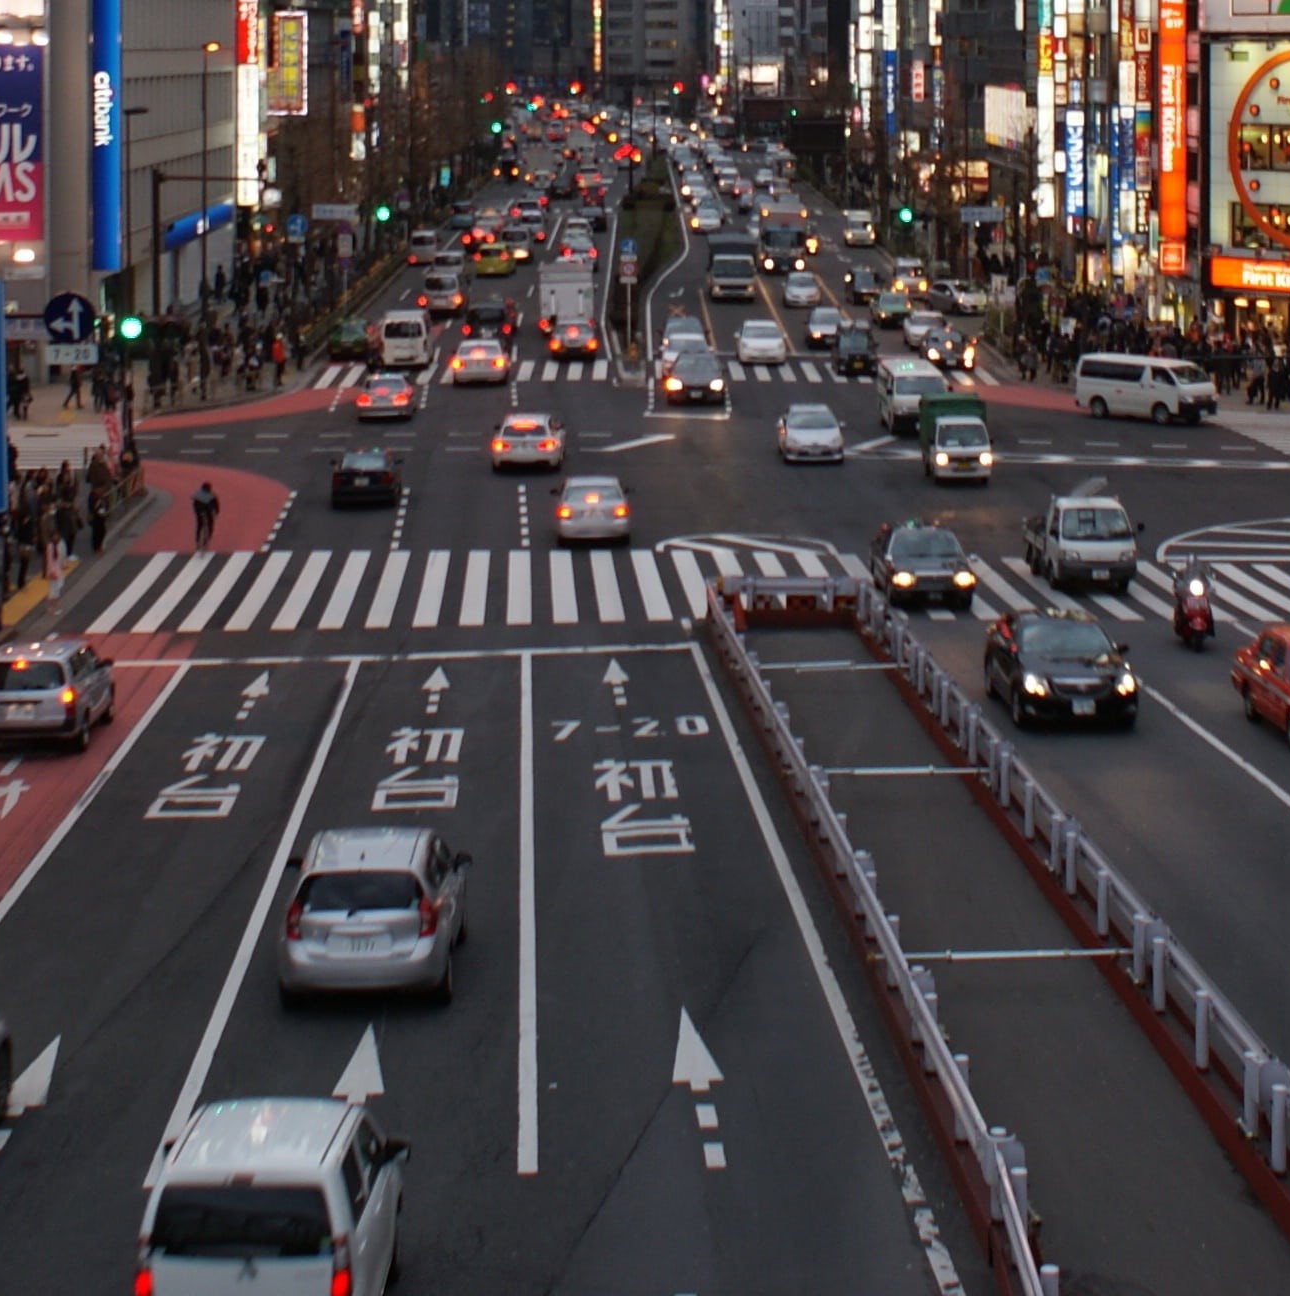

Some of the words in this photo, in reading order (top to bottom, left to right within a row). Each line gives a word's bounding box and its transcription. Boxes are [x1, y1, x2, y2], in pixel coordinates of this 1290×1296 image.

[93, 71, 114, 147] citibank
[1161, 64, 1176, 105] First
[1161, 106, 1174, 173] Kitchen
[1242, 271, 1274, 286] First
[144, 733, 266, 819] 初台
[371, 726, 464, 811] 初台
[592, 757, 696, 856] 初台
